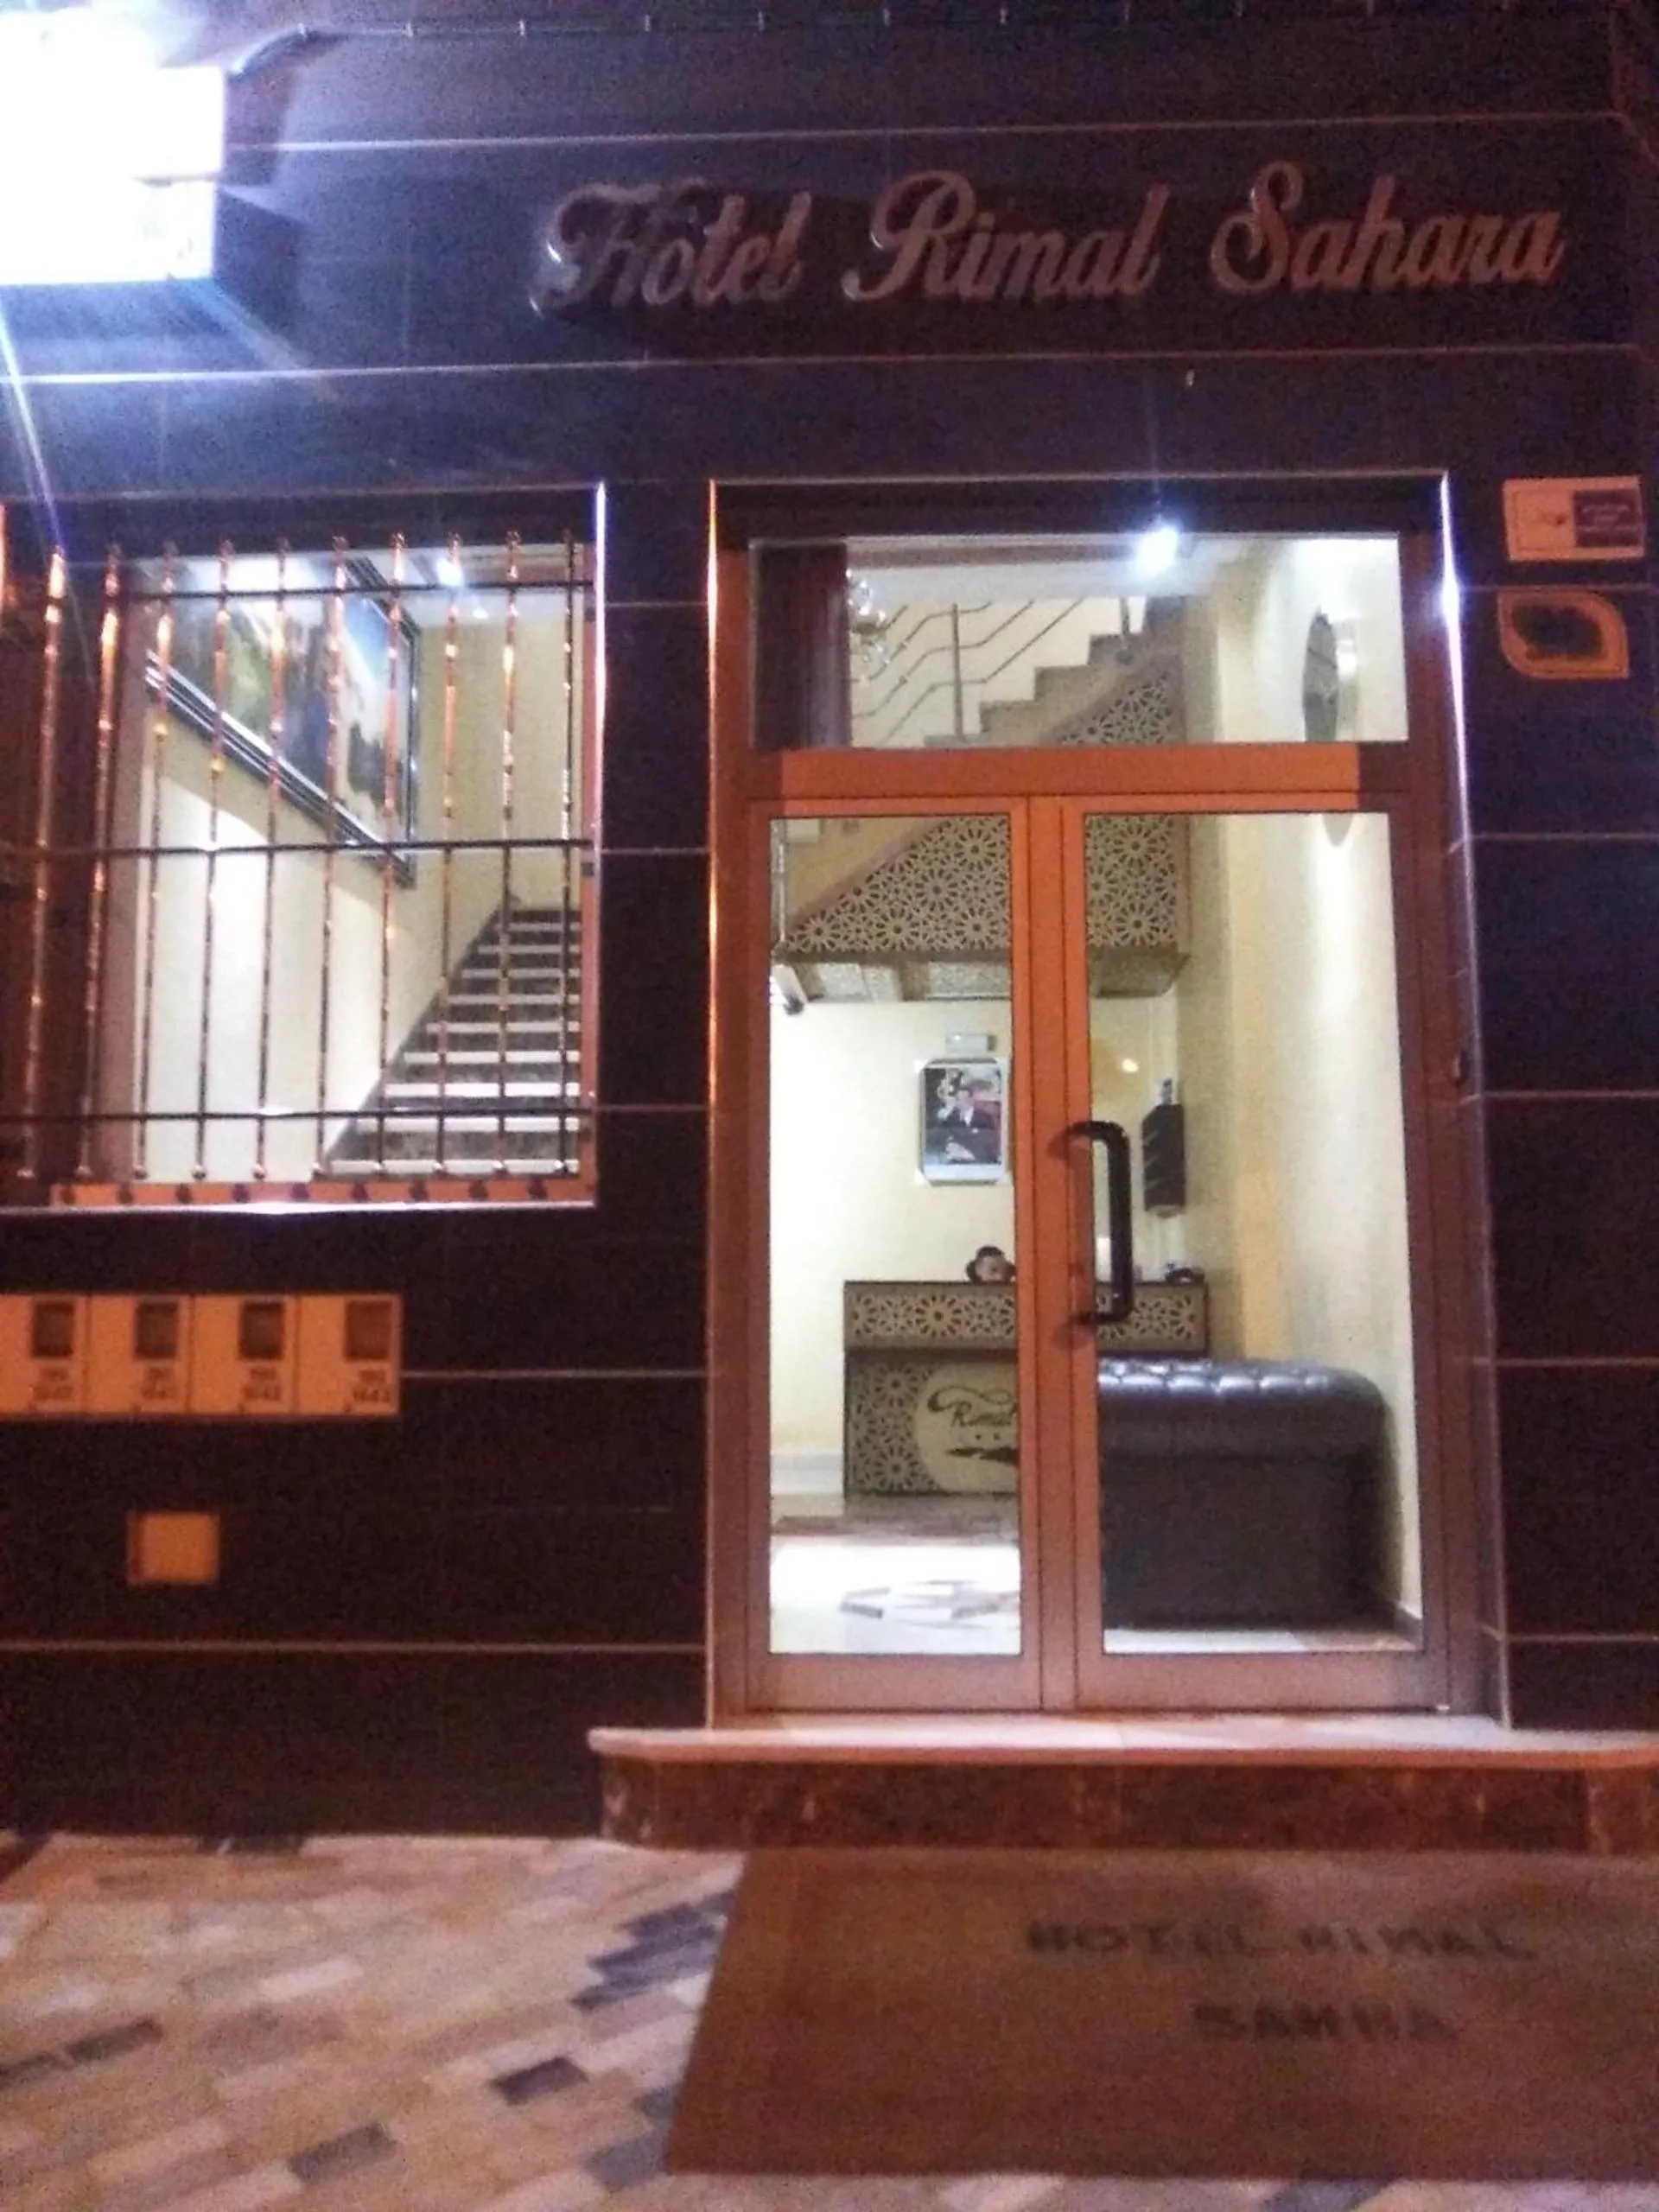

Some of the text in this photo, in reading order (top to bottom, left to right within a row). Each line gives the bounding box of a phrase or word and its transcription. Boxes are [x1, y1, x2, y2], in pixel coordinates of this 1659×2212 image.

[531, 160, 1565, 316] Hotel Rimal Sahara
